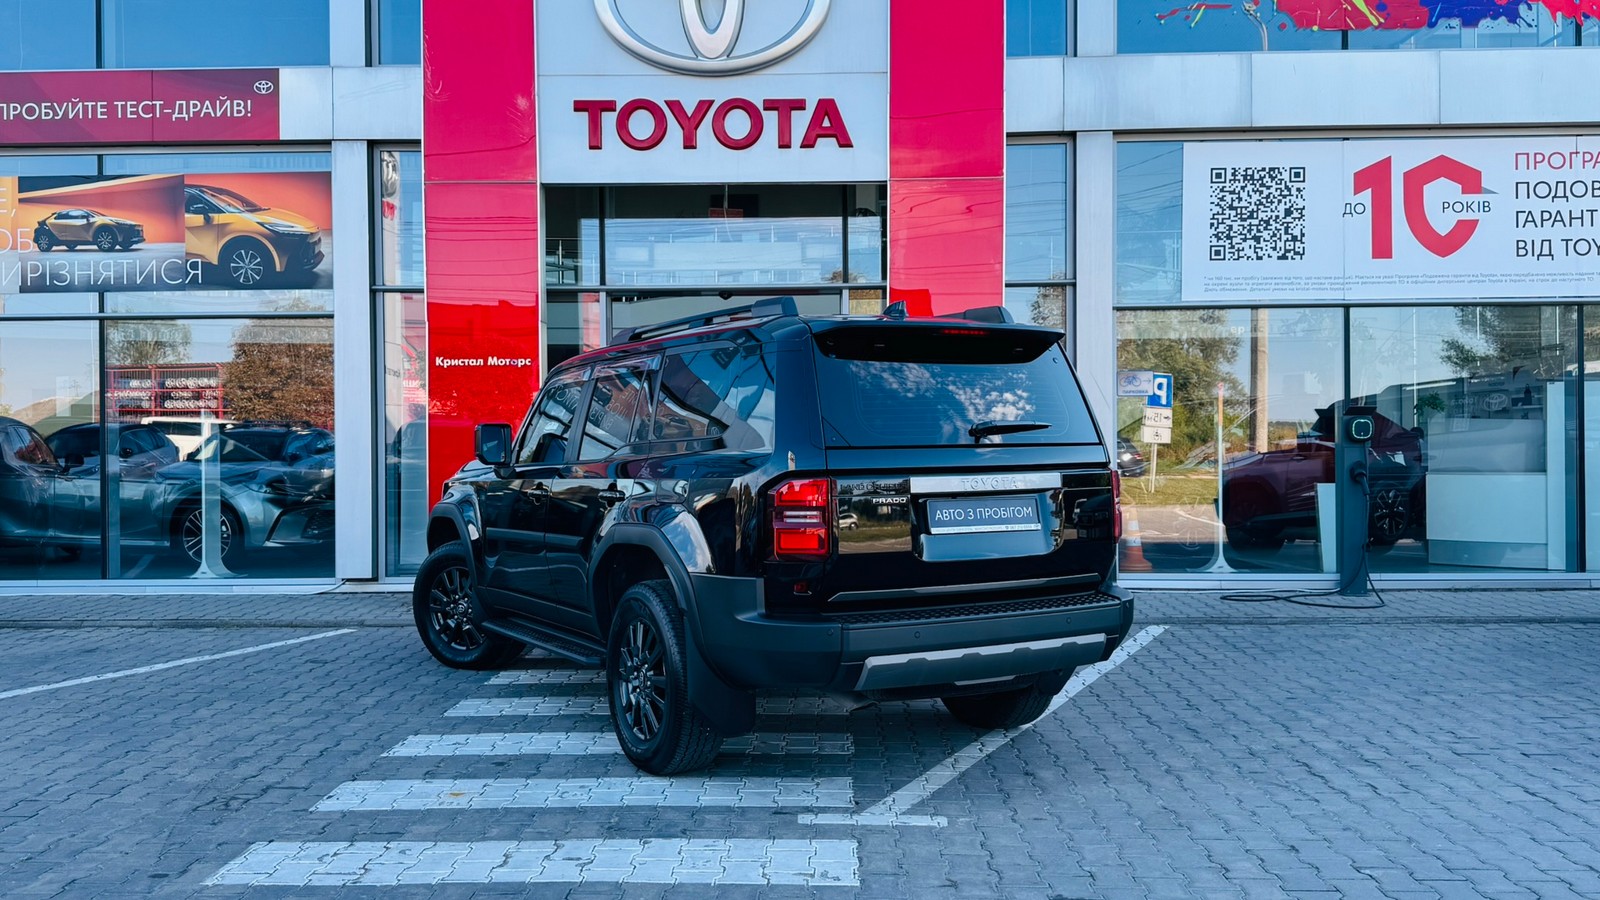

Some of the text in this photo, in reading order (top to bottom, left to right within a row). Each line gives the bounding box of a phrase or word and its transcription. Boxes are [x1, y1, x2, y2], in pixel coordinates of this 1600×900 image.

[114, 96, 252, 122] ТЕСТ-ДРАЙВ!
[573, 97, 854, 151] TOYOTA
[1342, 202, 1366, 218] ДО
[1442, 200, 1492, 214] РОКІВ
[1516, 209, 1598, 228] ГАРАНТ
[1516, 239, 1554, 261] ВІД
[435, 356, 532, 368] Кристал Моторс
[961, 477, 1019, 490] TOYOTA
[935, 506, 1033, 521] АВТО З ПРОБІГОМ
